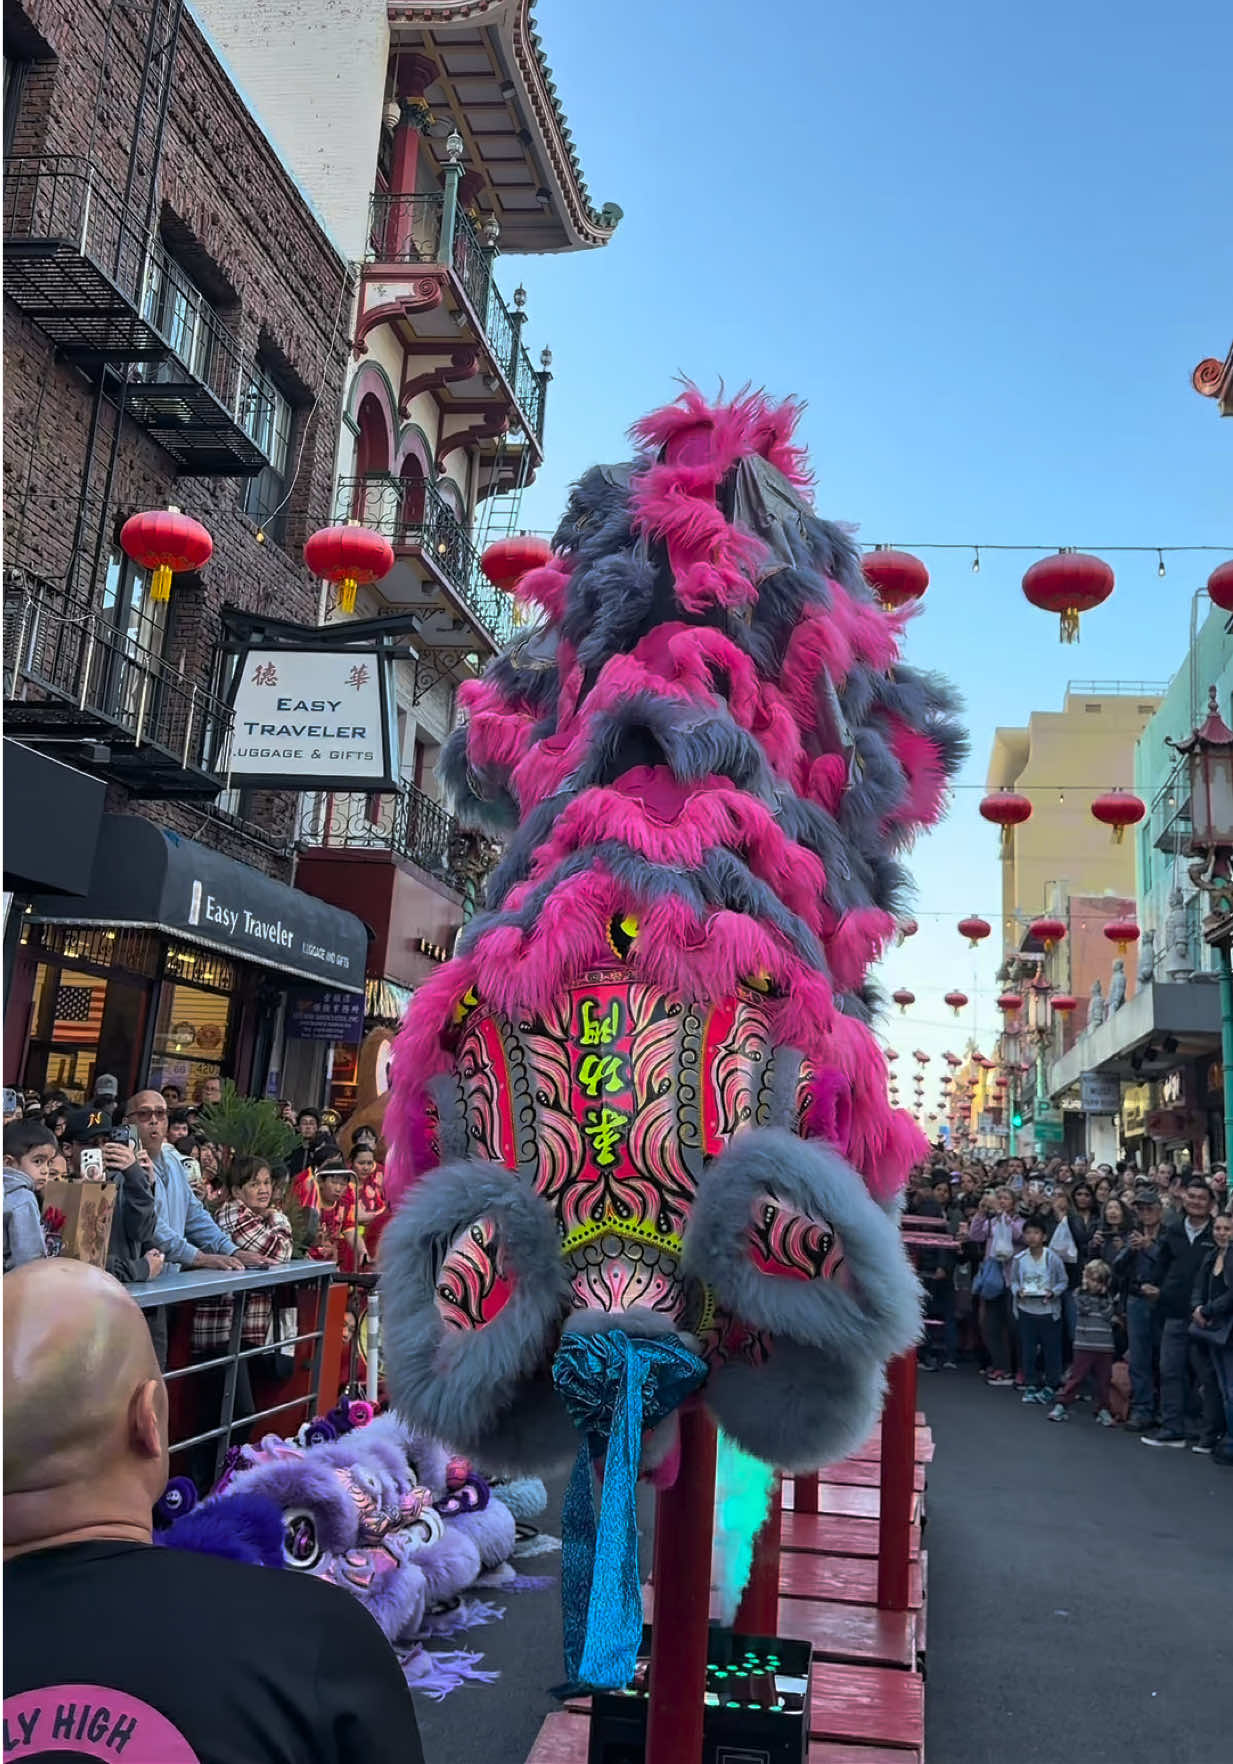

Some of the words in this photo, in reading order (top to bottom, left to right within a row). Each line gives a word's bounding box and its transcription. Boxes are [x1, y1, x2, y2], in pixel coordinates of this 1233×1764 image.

[251, 661, 279, 687] 德
[345, 664, 371, 691] 華
[276, 698, 342, 712] EASY
[244, 722, 367, 739] TRAVELER
[232, 748, 304, 760] UGGAGE
[310, 749, 321, 760] &
[329, 750, 374, 761] GIFTS
[206, 897, 238, 932] Easy
[244, 911, 294, 946] Traveler
[52, 1703, 138, 1754] HIGH
